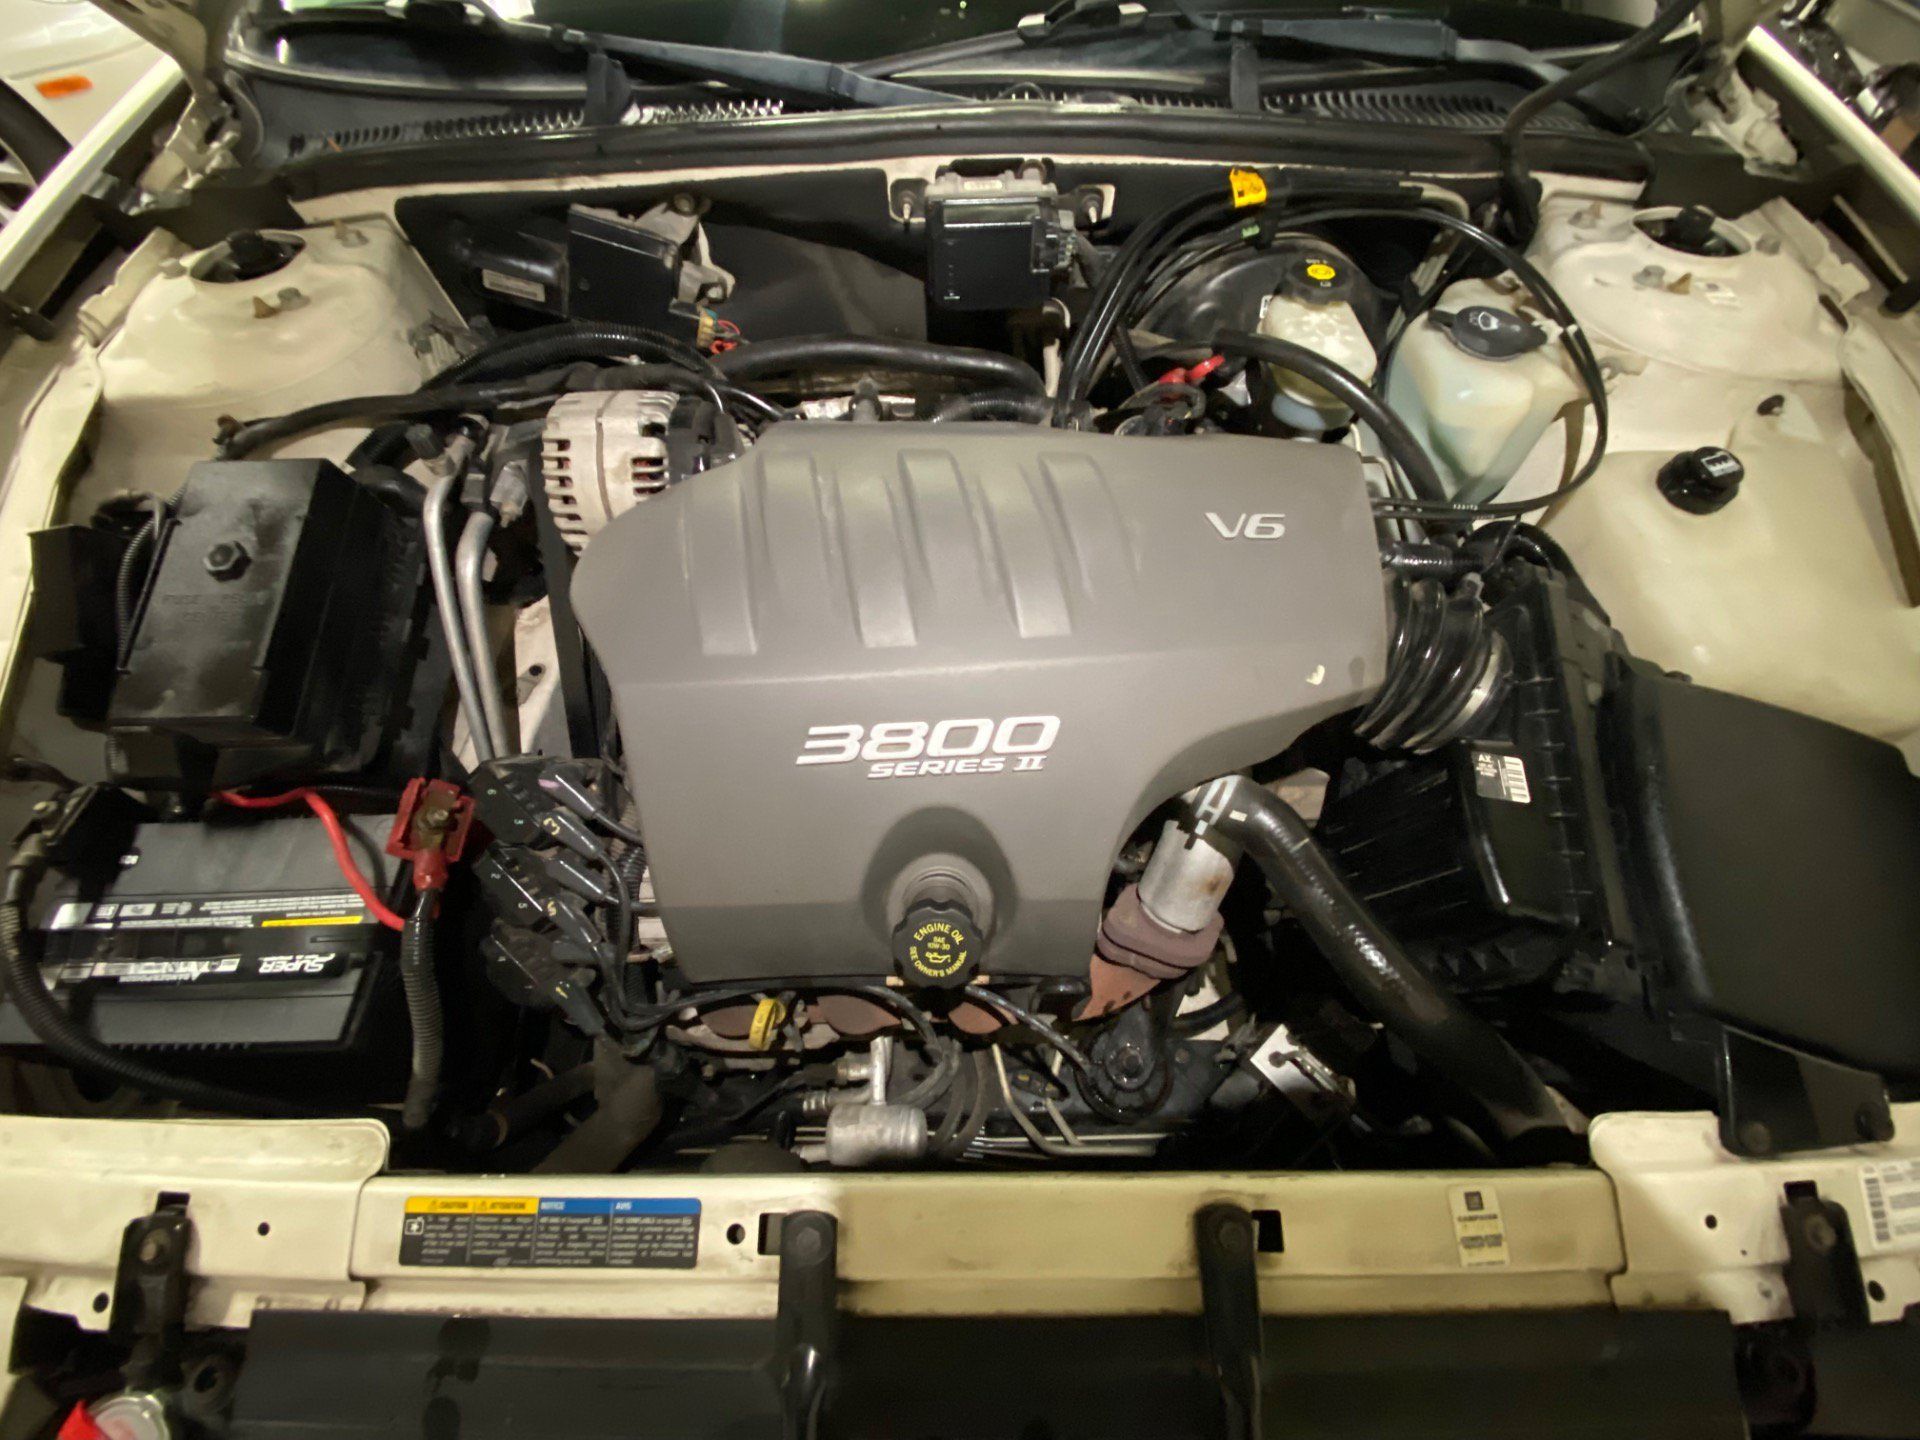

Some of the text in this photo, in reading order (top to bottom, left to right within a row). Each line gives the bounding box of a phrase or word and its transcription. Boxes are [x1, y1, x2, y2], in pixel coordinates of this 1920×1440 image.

[1204, 512, 1286, 539] V6
[796, 715, 1061, 764] 3800
[867, 755, 1047, 779] SERIES II
[914, 923, 964, 945] ENGINE OIL
[258, 959, 326, 974] SUPER
[909, 946, 967, 977] SEE OWNER'S MANUAL
